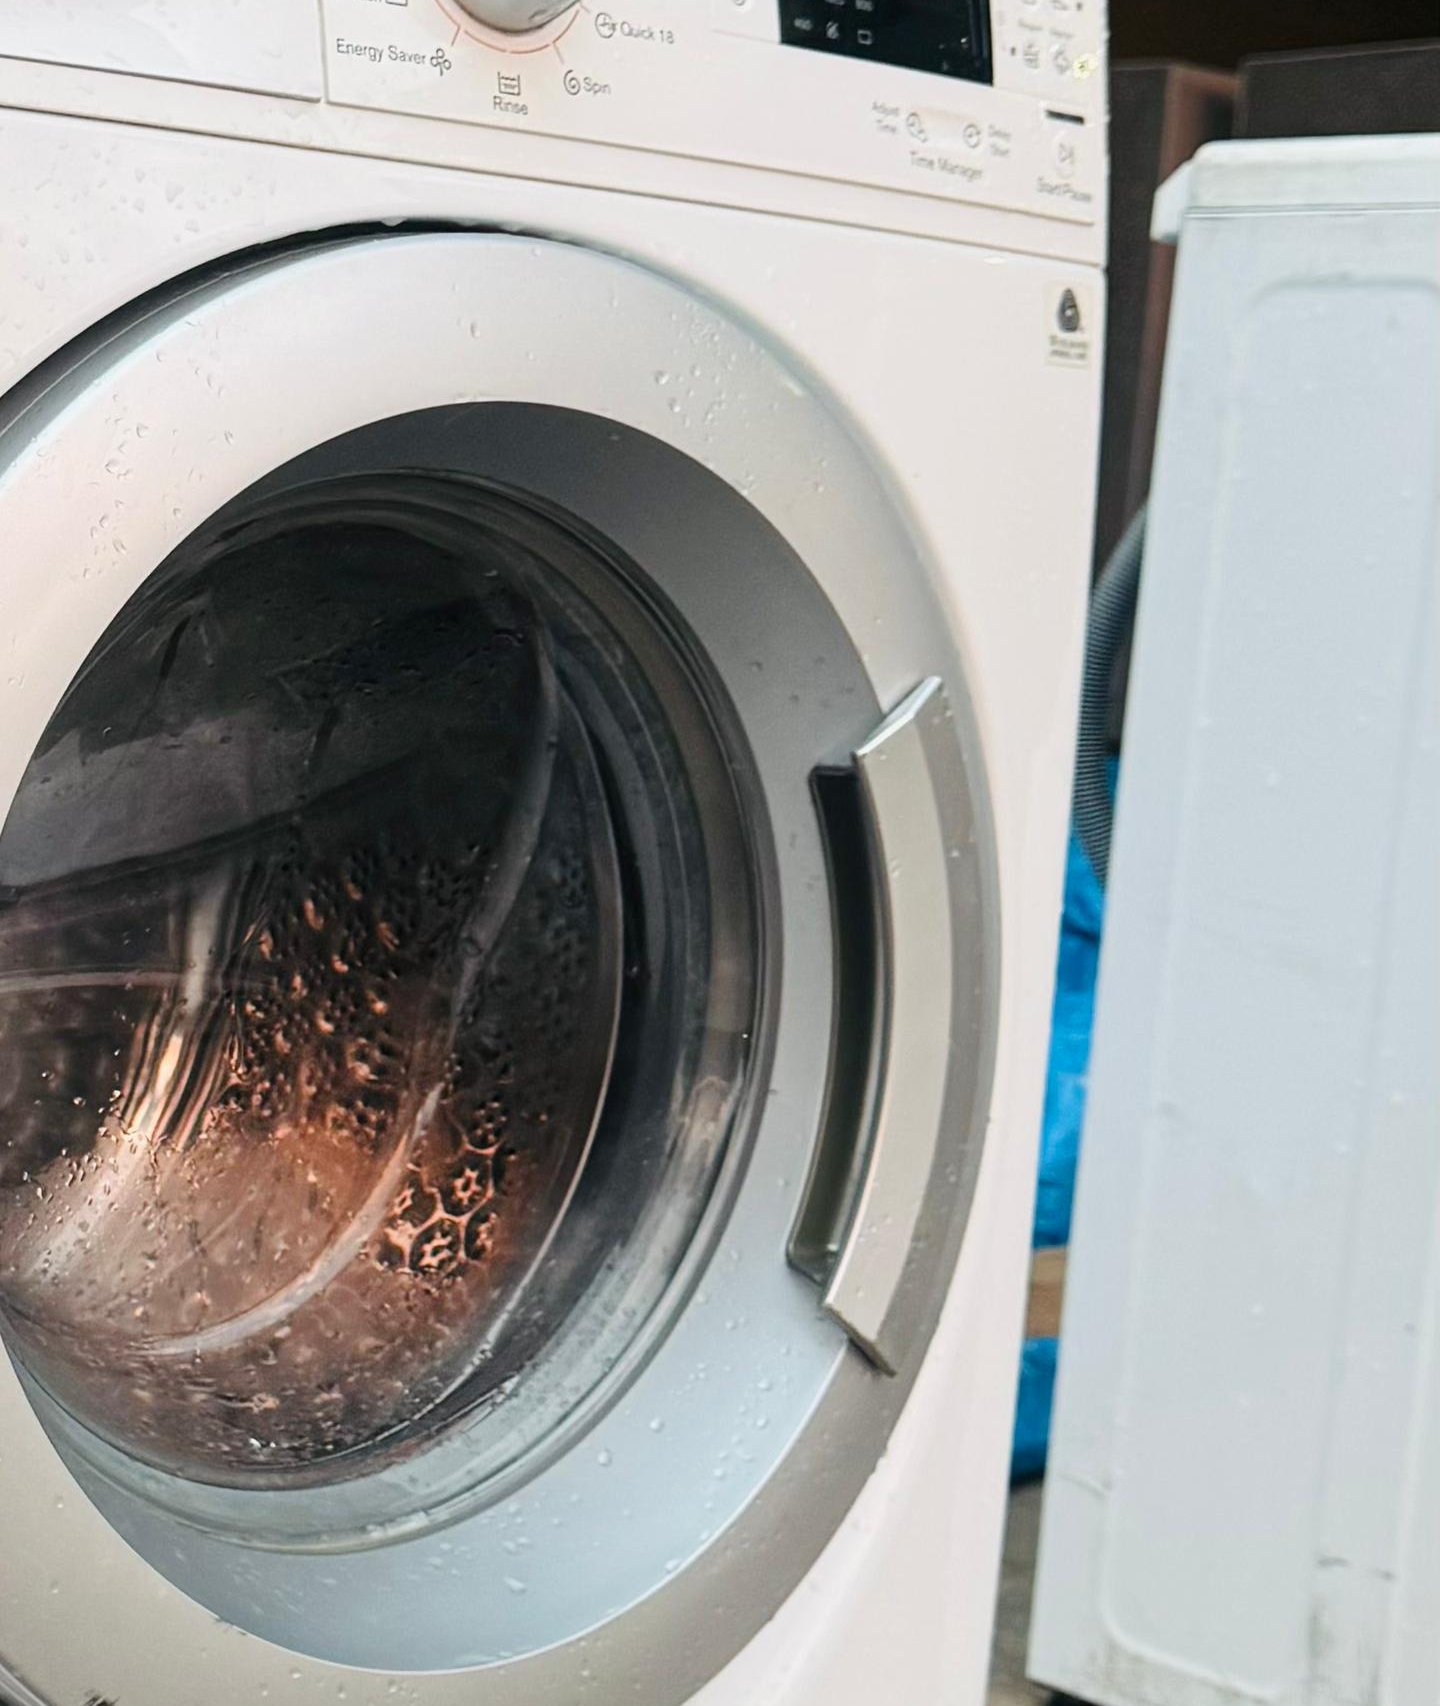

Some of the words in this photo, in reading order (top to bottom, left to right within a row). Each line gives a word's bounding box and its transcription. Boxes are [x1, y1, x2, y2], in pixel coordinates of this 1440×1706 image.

[620, 20, 655, 42] Quick
[336, 37, 385, 64] Energy
[388, 44, 427, 66] Saver
[582, 76, 612, 97] Spin
[492, 94, 529, 116] Rinse
